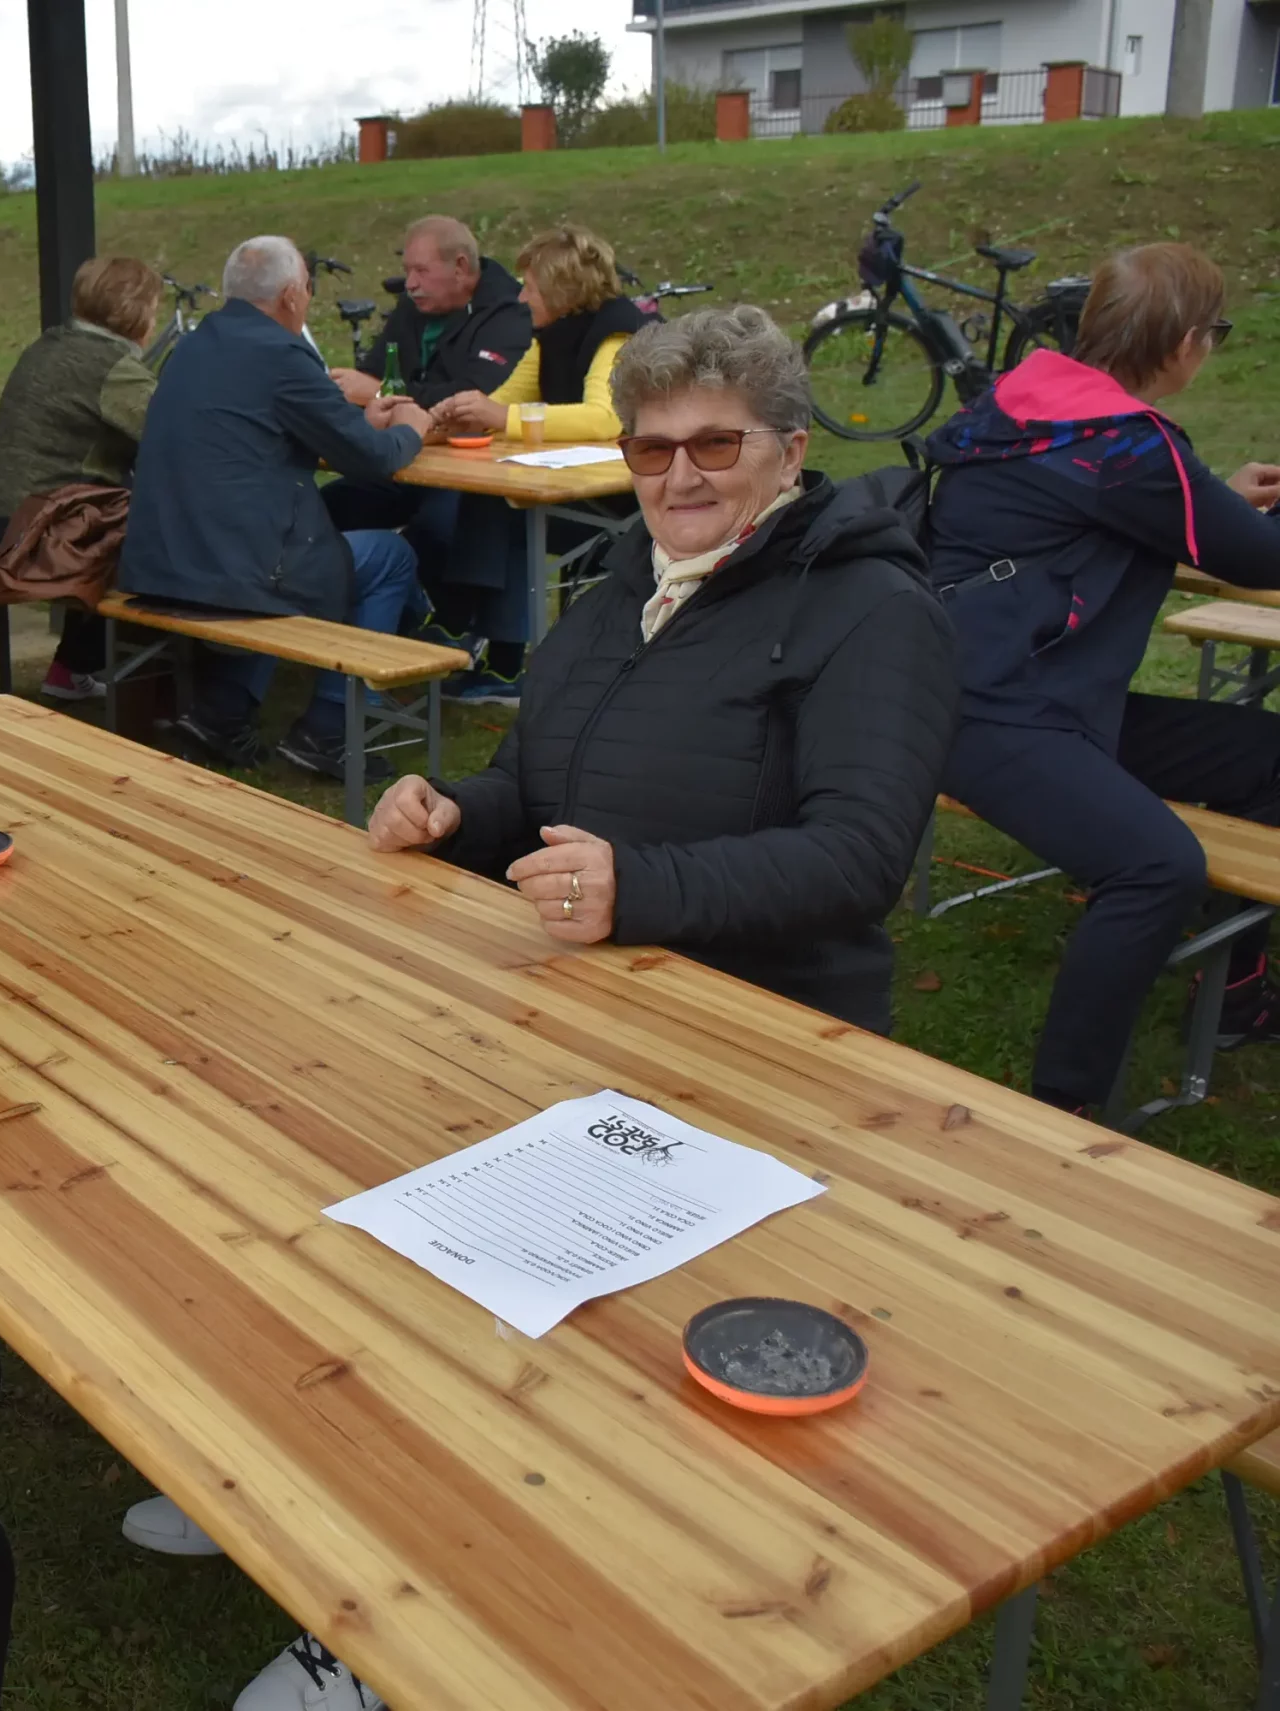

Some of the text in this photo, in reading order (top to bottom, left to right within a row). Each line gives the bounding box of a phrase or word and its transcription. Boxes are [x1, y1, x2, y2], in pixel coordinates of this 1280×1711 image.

[589, 1124, 647, 1155] POD
[596, 1115, 660, 1147] BREST
[426, 1239, 476, 1264] DONACIJE
